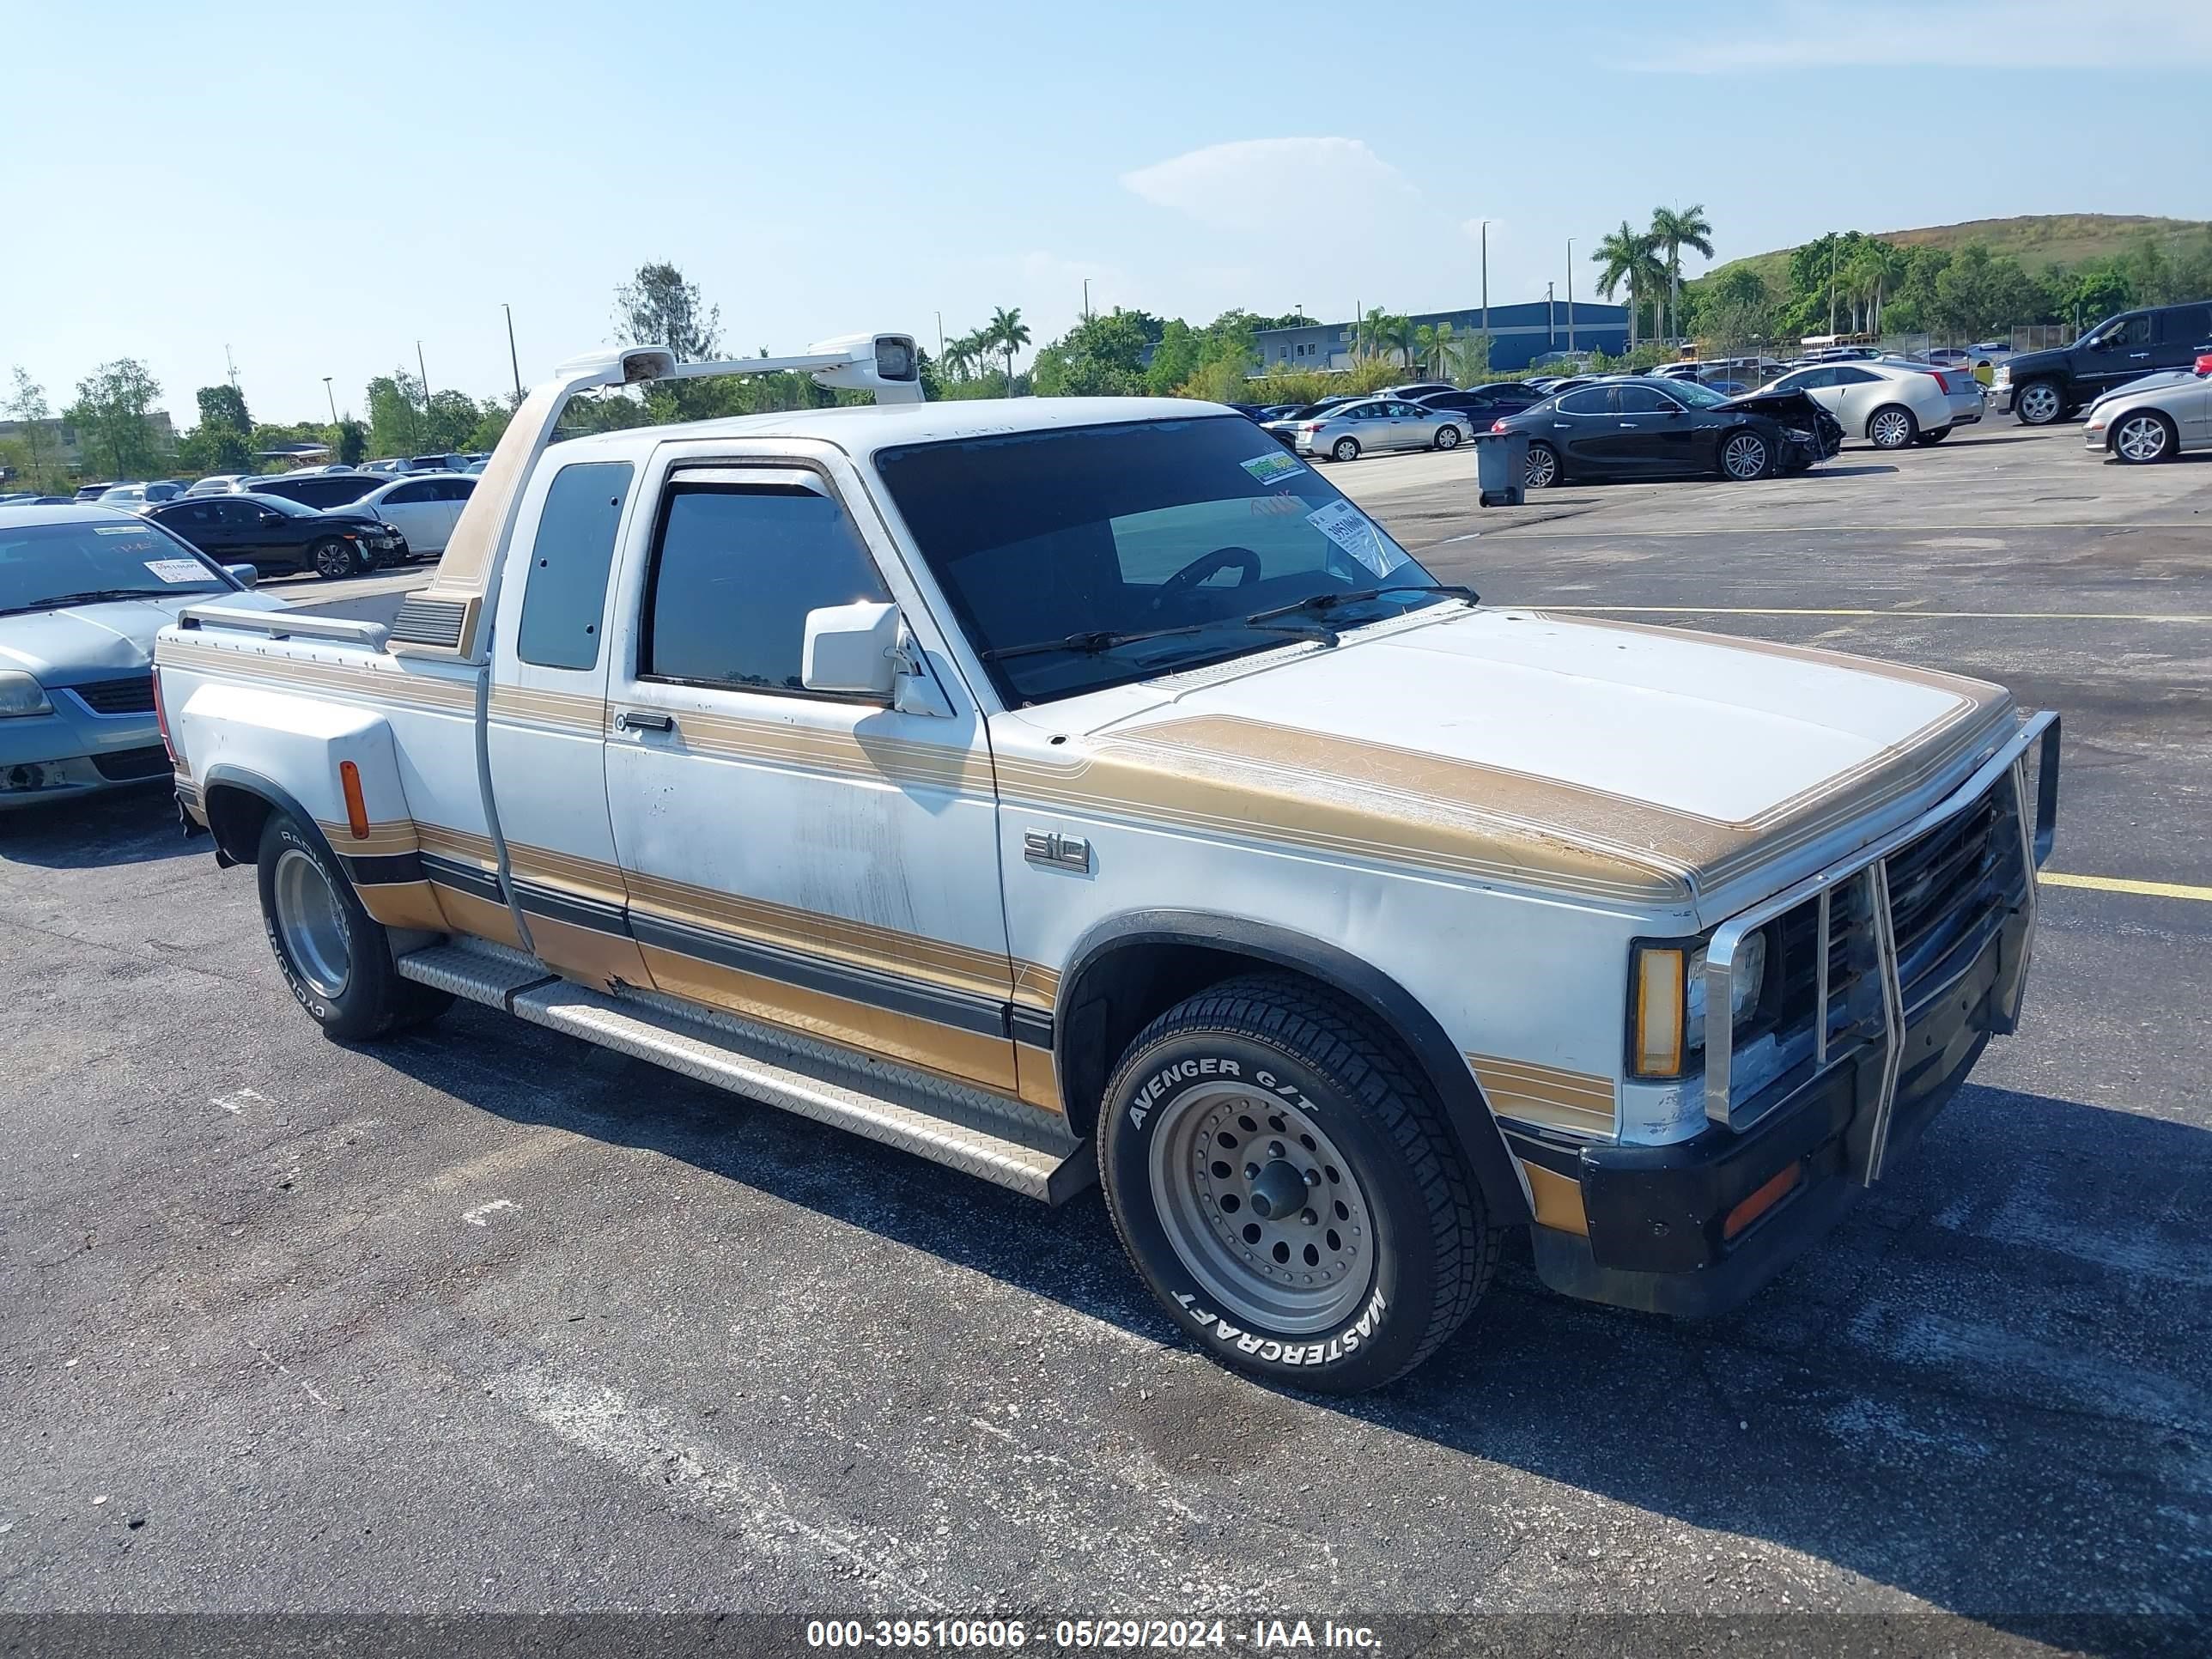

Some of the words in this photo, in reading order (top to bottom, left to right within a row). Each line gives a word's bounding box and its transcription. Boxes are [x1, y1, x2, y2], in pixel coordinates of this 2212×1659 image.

[1328, 514, 1366, 540] 39510606
[264, 916, 325, 1018] CYCLONE
[1128, 1058, 1241, 1132] AVENGER
[1255, 1071, 1319, 1113] G/T
[1170, 1286, 1387, 1365] MASTERCRAFT
